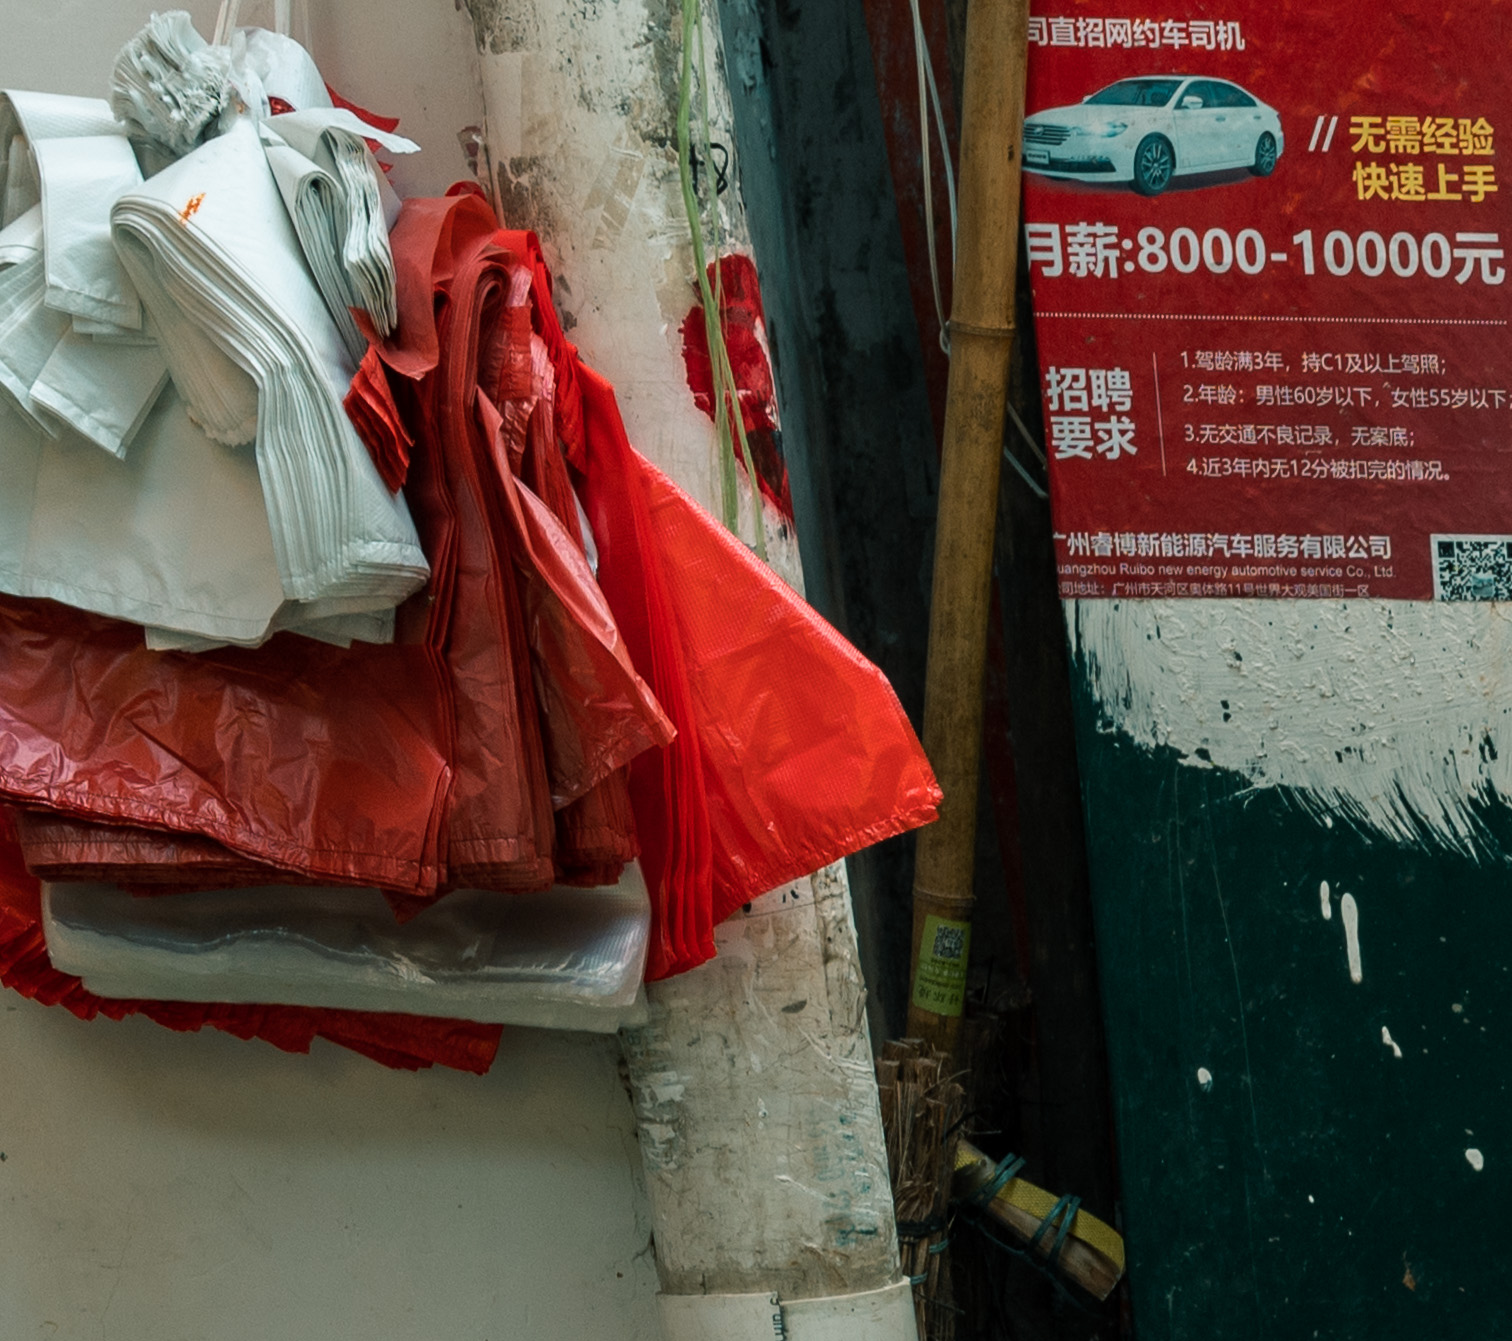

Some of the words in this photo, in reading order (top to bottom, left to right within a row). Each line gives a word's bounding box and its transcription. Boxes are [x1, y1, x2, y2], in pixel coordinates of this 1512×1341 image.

[1349, 115, 1496, 156] 无需经验
[1352, 161, 1499, 203] 快速上手
[1045, 365, 1134, 413] 招聘
[1049, 414, 1139, 461] 要求
[1056, 563, 1117, 578] uangzhou
[1119, 562, 1155, 576] Ruibo
[1158, 565, 1183, 576] new
[1186, 565, 1228, 580] energy
[1231, 564, 1298, 578] automotive
[1300, 565, 1343, 578] service
[1374, 565, 1397, 578] Ltd.
